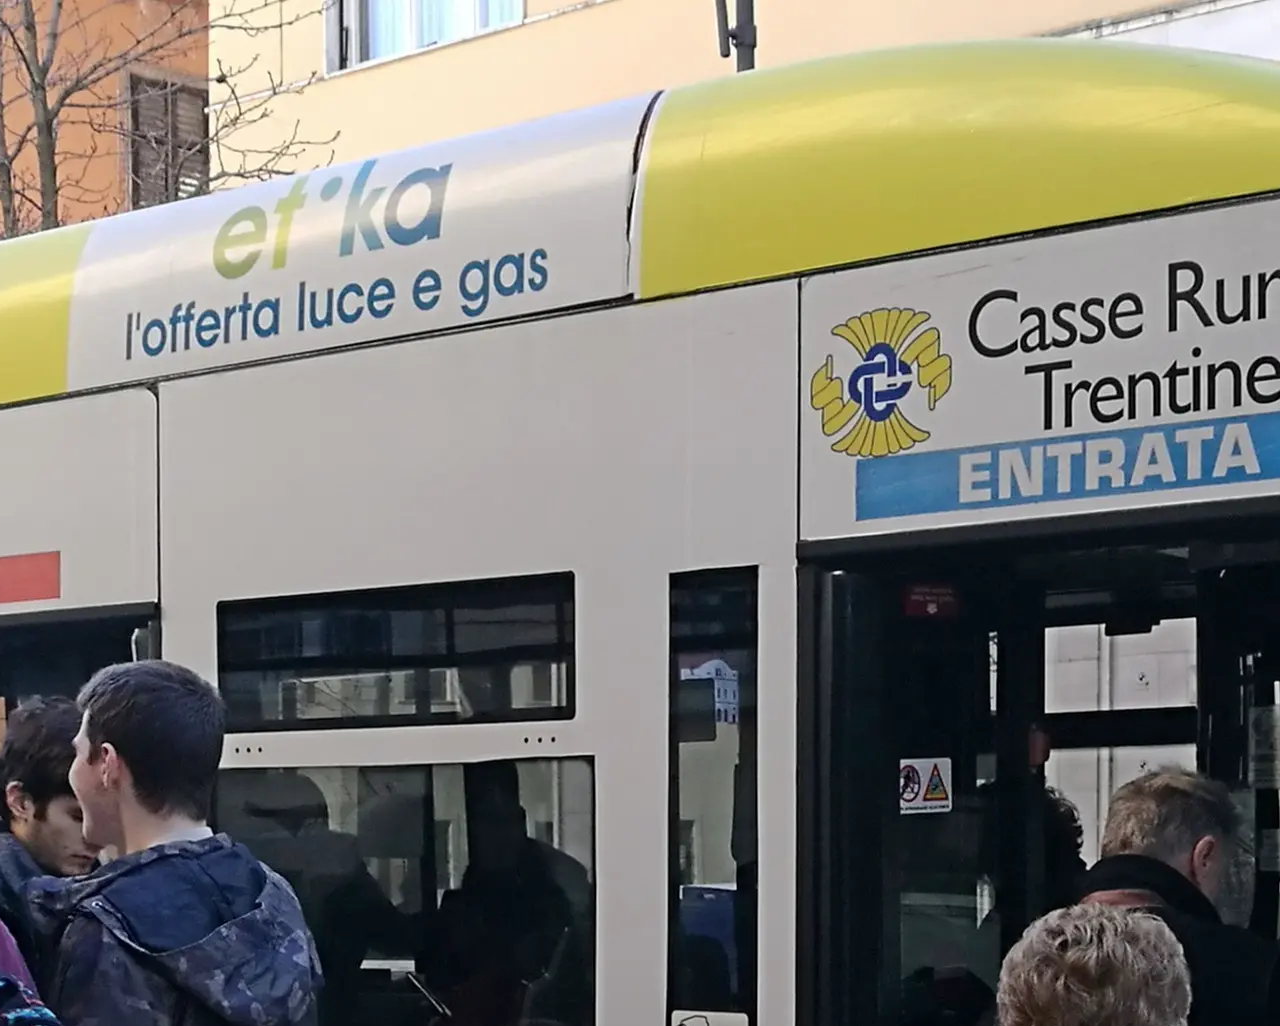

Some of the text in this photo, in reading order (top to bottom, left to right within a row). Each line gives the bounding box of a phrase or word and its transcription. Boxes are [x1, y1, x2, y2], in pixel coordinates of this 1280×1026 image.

[125, 247, 549, 361] l'offerta luce e gas
[968, 289, 1144, 360] Casse
[957, 422, 1261, 504] ENTRATA
